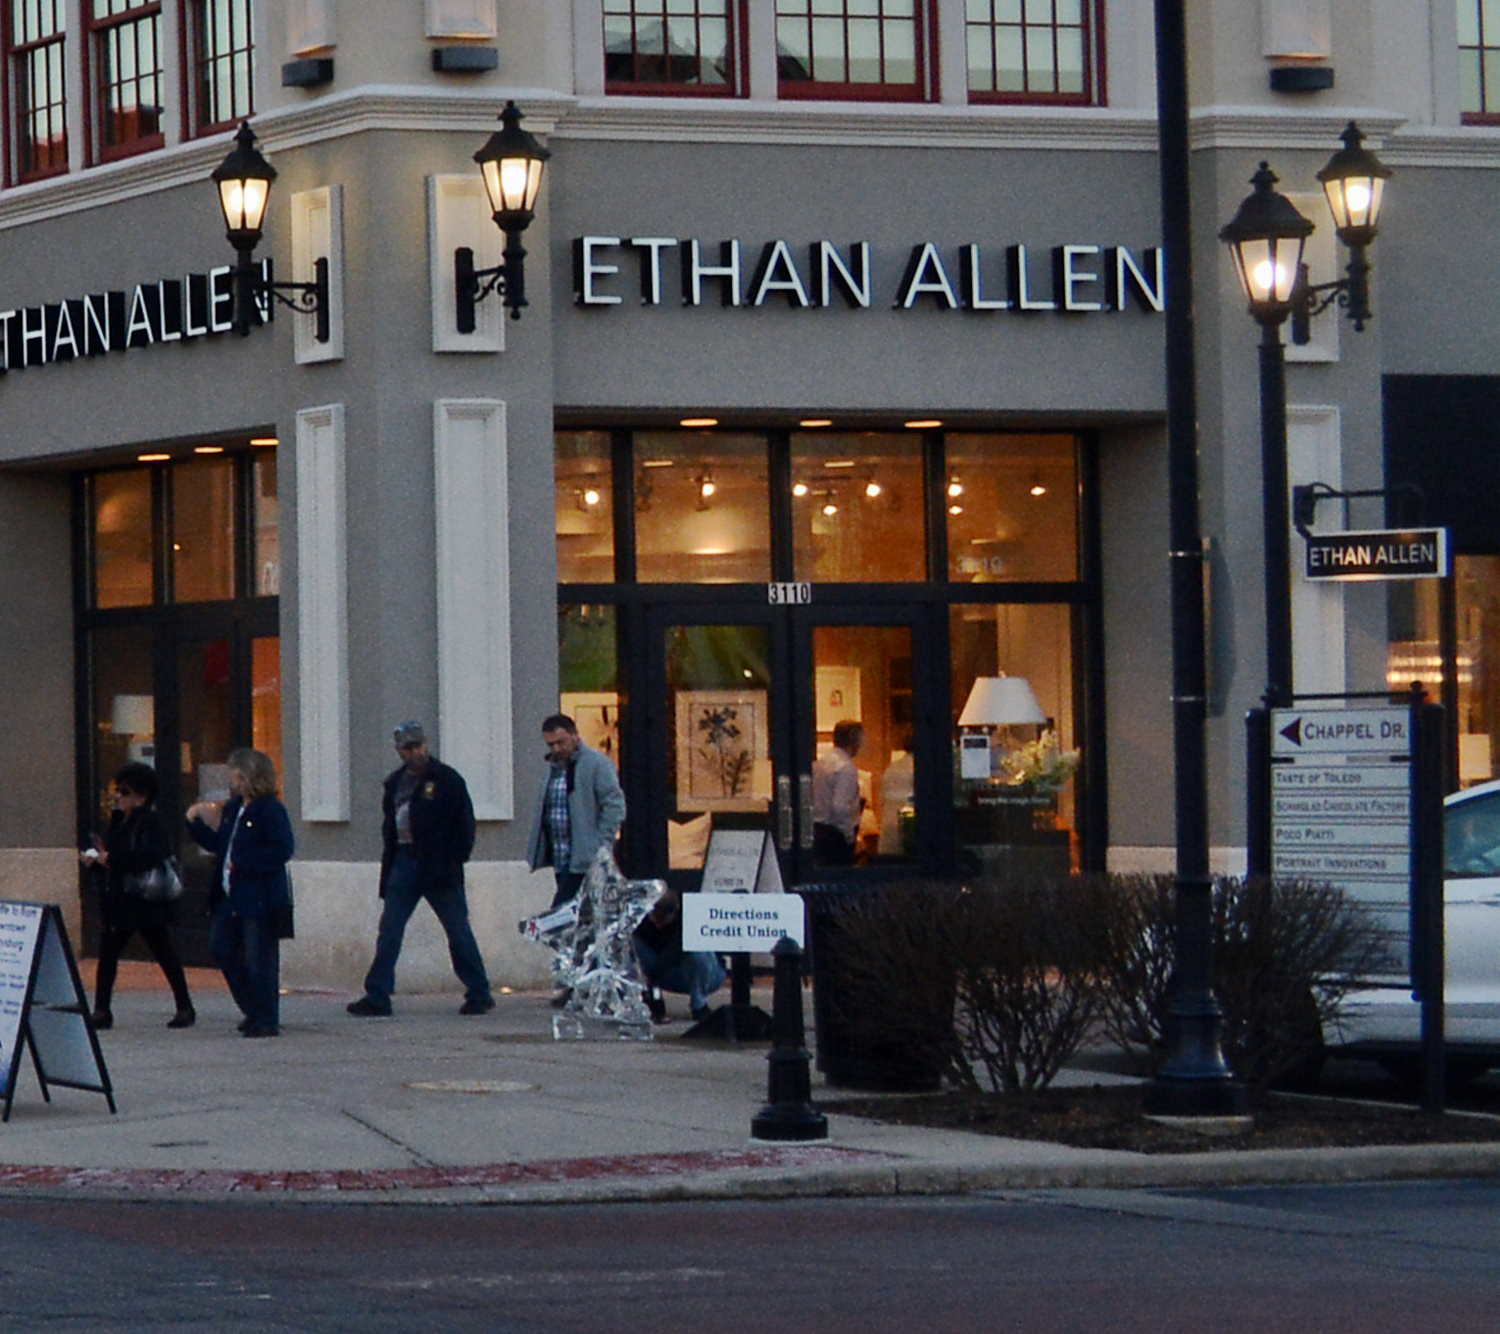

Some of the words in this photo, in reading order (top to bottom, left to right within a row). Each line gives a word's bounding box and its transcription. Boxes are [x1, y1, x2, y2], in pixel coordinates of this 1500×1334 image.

[582, 236, 870, 308] ETHAN
[903, 241, 1165, 312] ALLEN
[1310, 545, 1371, 567] ETHAN
[1374, 543, 1434, 565] ALLEN
[769, 584, 810, 603] 3110
[1304, 722, 1374, 740] CHAPPEL
[709, 908, 779, 920] Directions
[700, 925, 742, 937] Credit
[747, 925, 788, 938] Union
